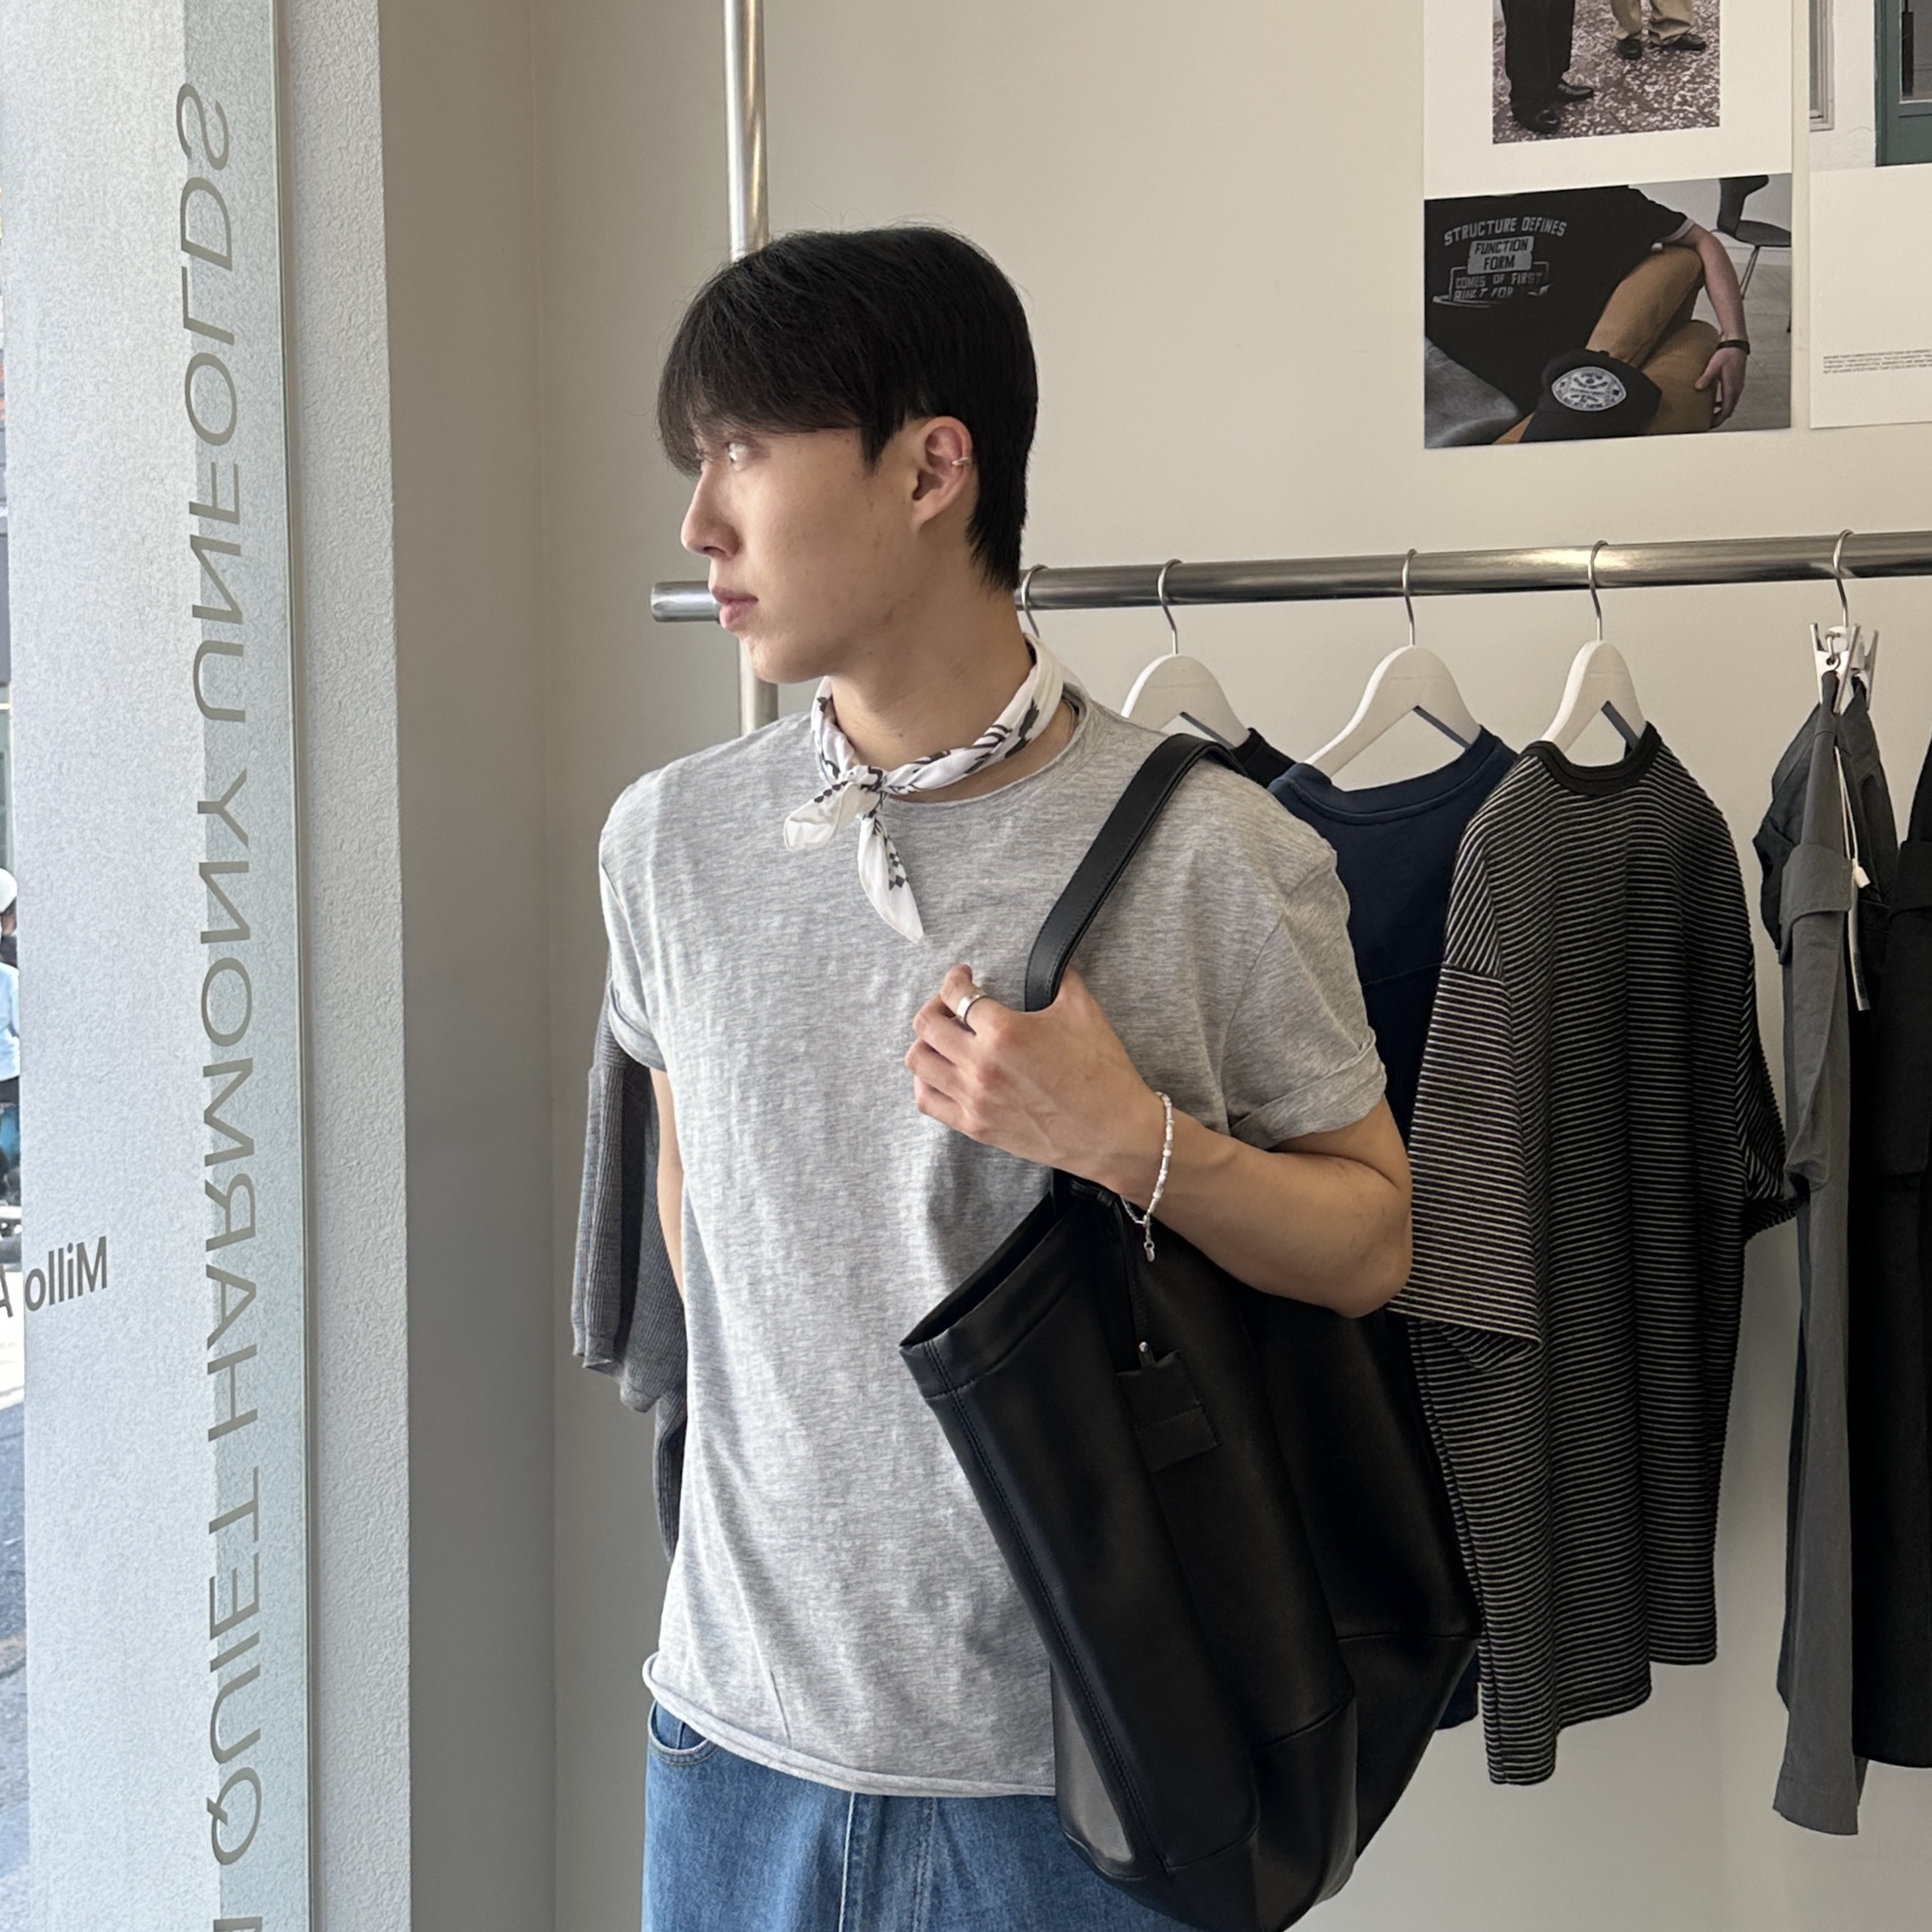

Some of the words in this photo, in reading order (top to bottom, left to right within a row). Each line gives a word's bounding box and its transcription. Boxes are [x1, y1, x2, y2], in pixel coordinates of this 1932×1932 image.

[1444, 218, 1517, 246] STRUCTURE
[1521, 216, 1568, 237] DEFINES
[1474, 238, 1529, 255] FUNCTION
[1484, 255, 1516, 271] FORM
[1511, 271, 1543, 284] FIRST
